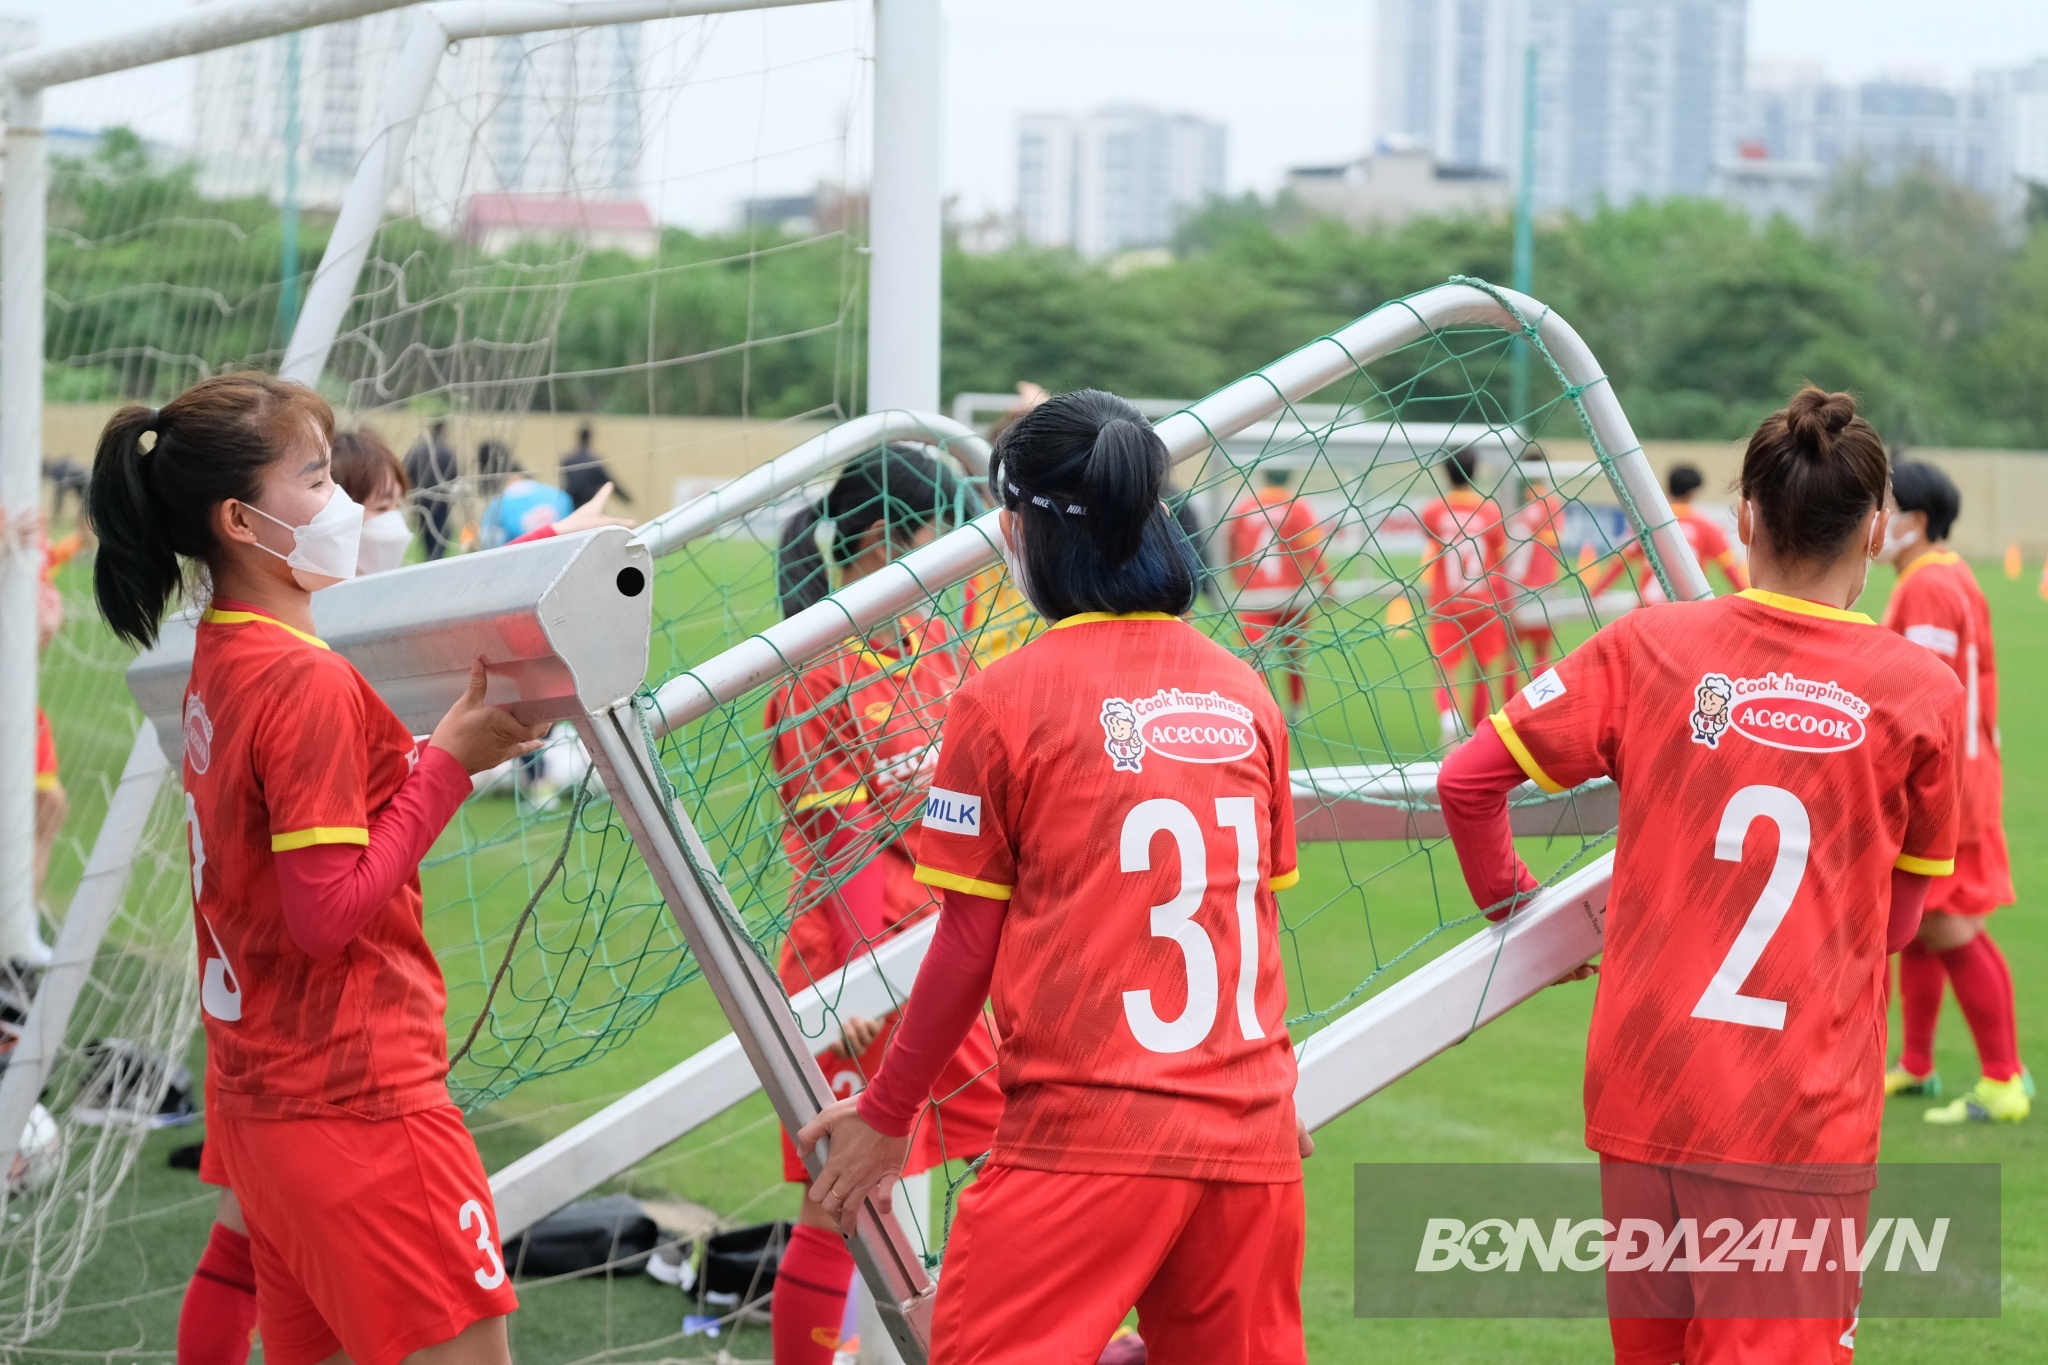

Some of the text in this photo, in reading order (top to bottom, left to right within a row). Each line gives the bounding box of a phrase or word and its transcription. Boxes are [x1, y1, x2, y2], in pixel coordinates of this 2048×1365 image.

[1008, 482, 1088, 516] NIKE NIKE NIKE
[1135, 691, 1251, 720] Cook happiness
[1735, 676, 1867, 715] Cook happiness
[926, 796, 976, 826] MILK
[1119, 796, 1266, 1054] 31
[1689, 784, 1811, 1031] 2
[458, 1199, 505, 1290] 3
